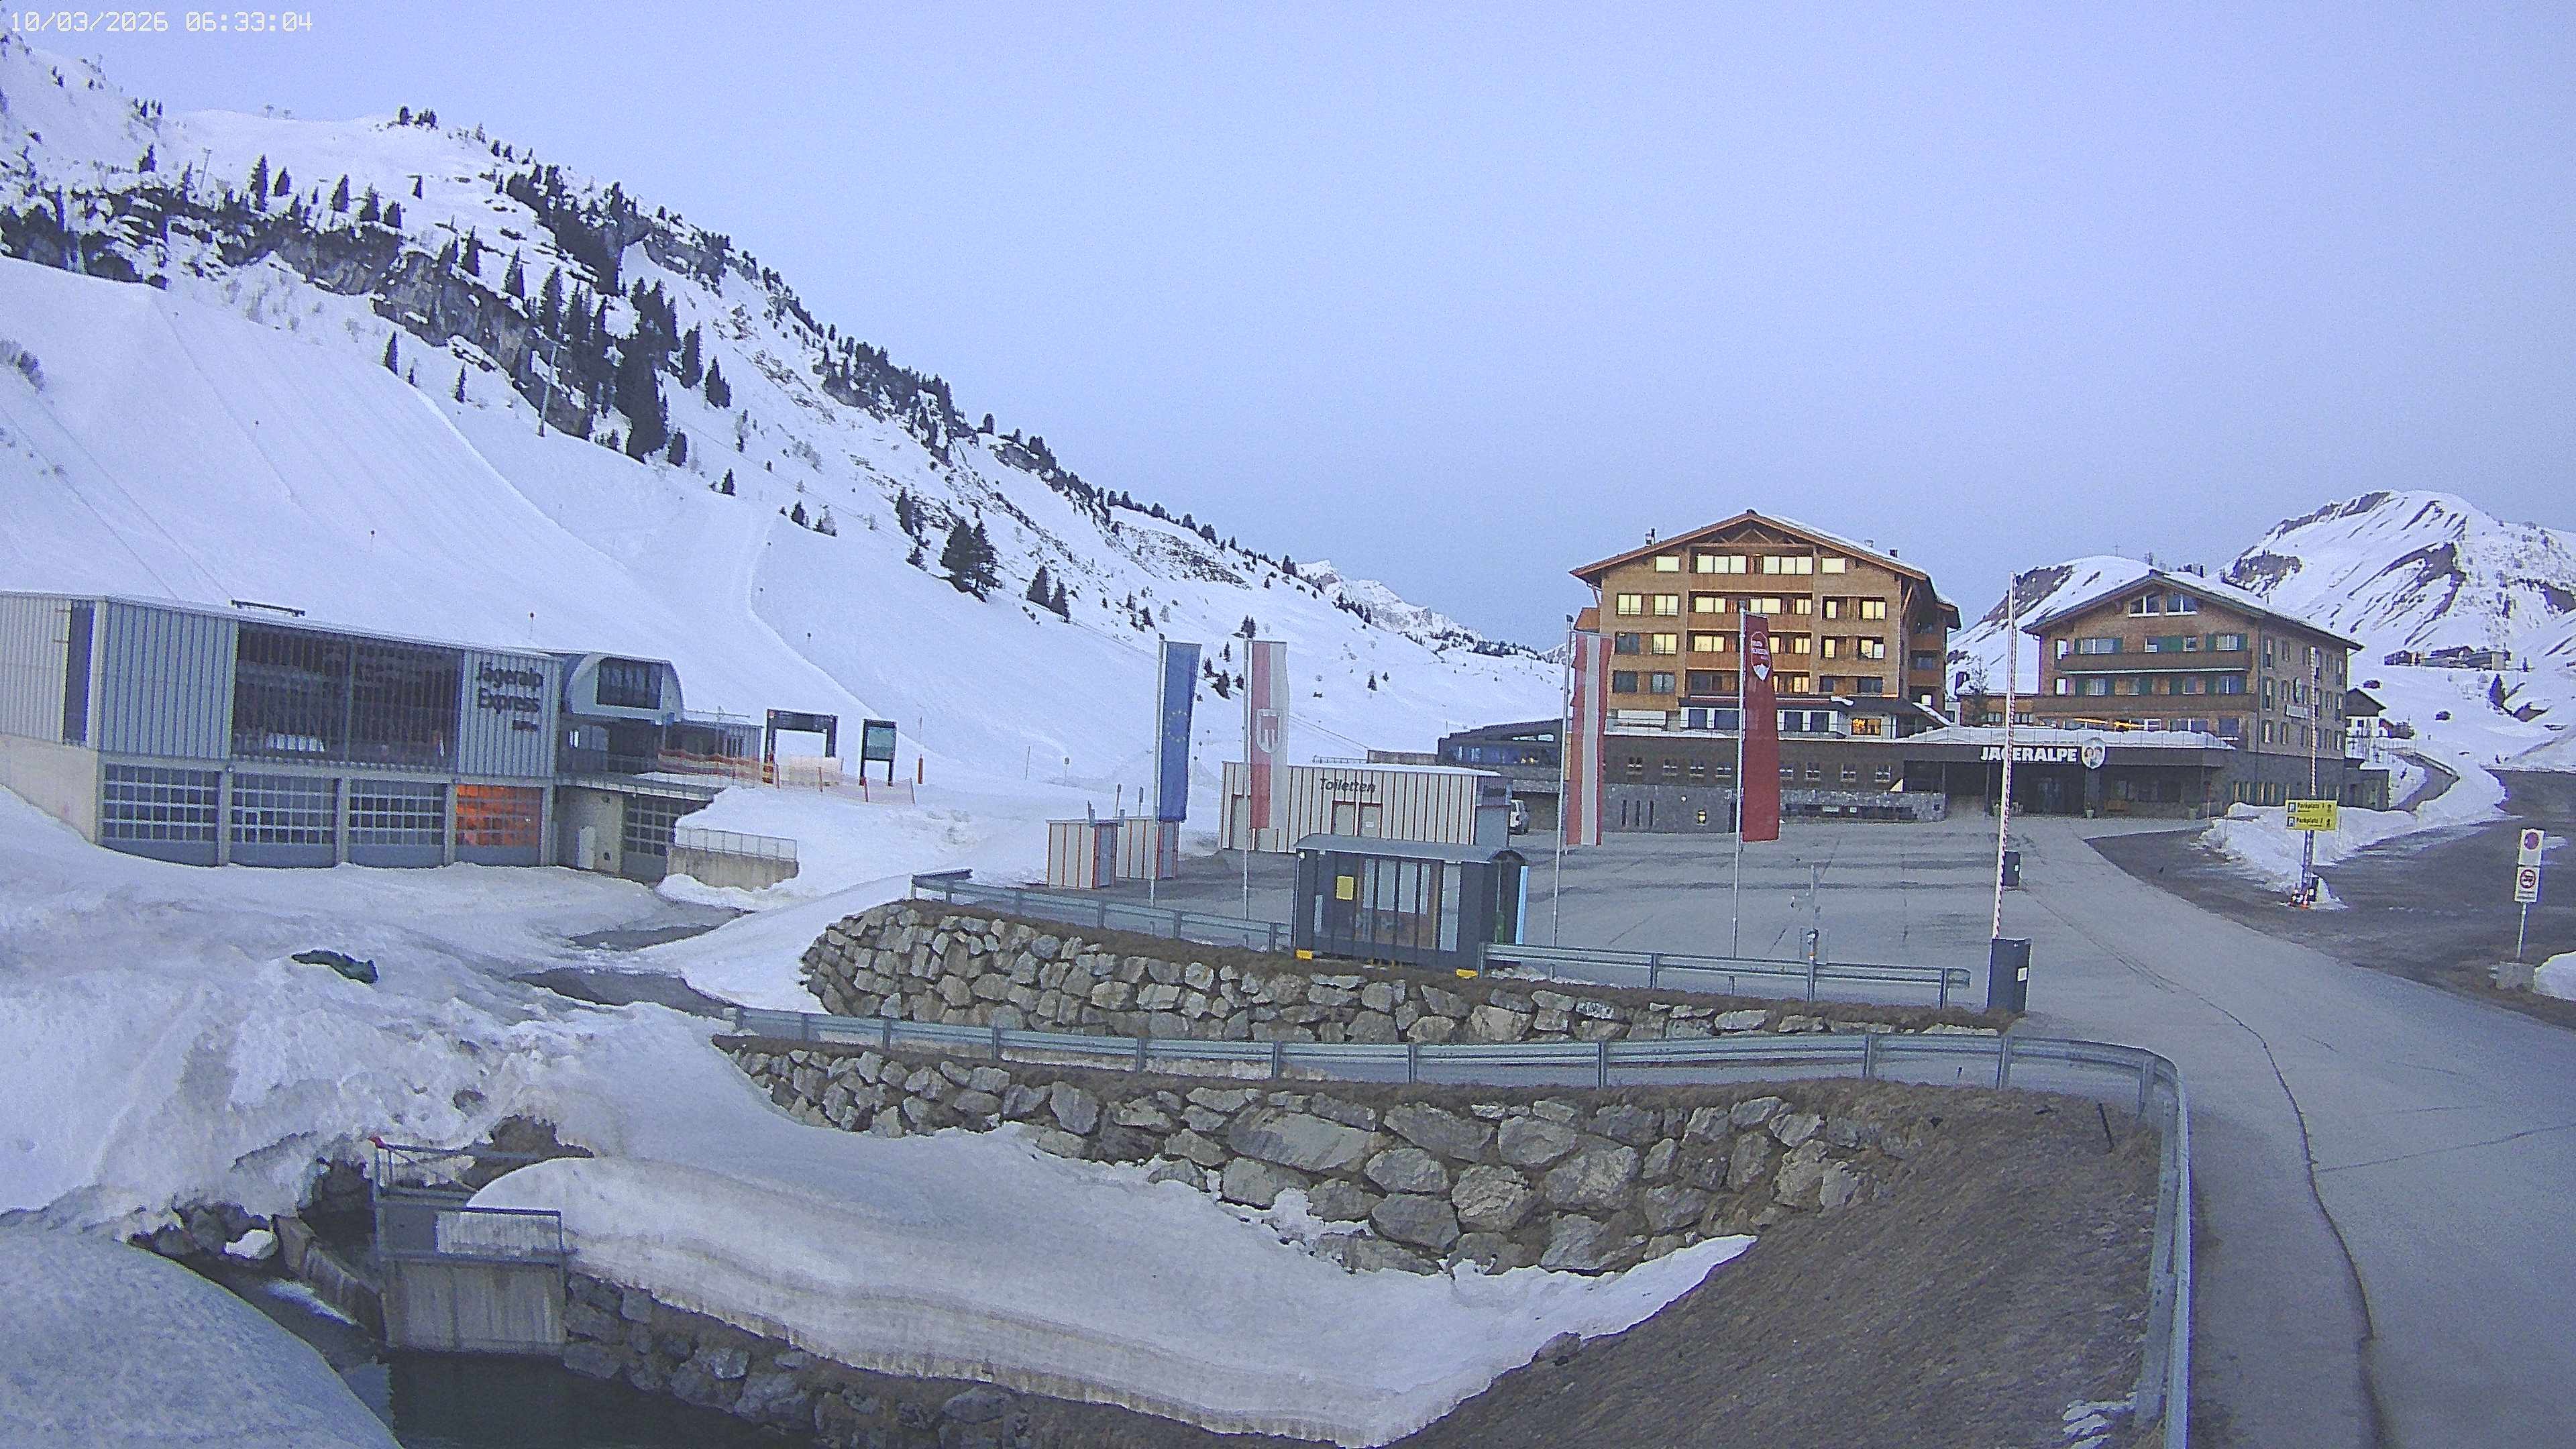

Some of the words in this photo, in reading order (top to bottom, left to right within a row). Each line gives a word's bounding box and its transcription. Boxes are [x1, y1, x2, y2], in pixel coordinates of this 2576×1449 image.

[476, 661, 544, 691] Jägeralp
[478, 686, 540, 713] Express
[1320, 777, 1376, 792] Toiletten
